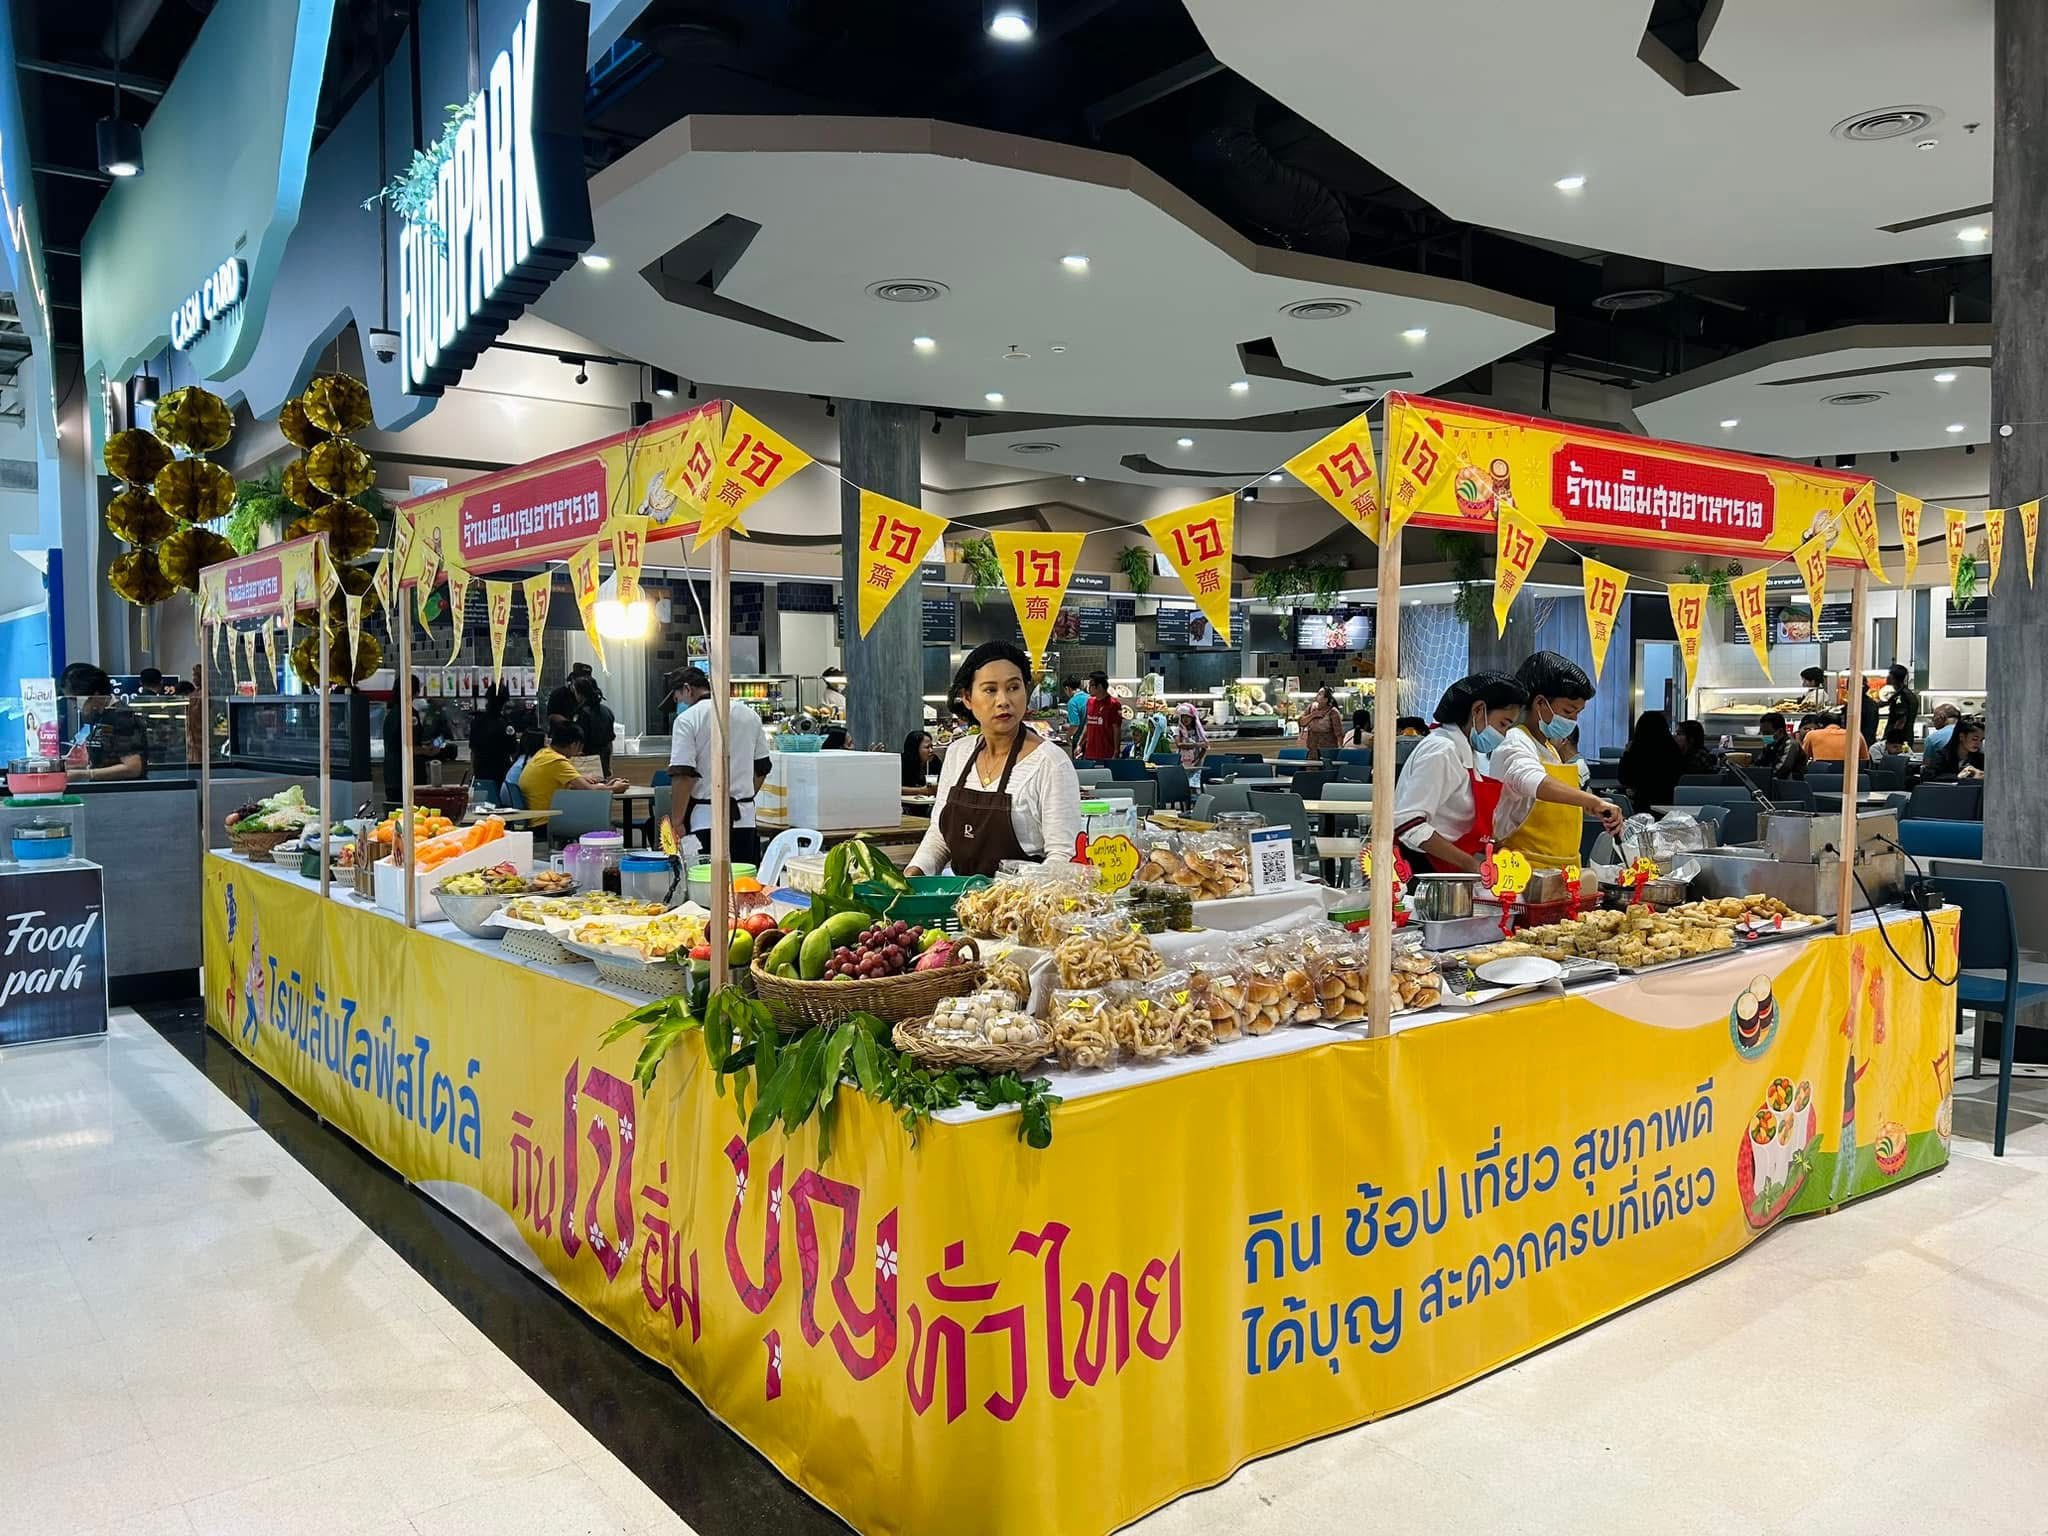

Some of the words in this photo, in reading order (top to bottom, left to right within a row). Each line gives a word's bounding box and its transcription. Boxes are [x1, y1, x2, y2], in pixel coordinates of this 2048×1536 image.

[171, 290, 201, 351] CASH
[203, 256, 240, 321] CARD
[725, 433, 783, 487] เจ
[1316, 442, 1373, 498] เจ
[1401, 431, 1439, 486] เจ
[463, 490, 600, 549] ร้านเติมบุญอาหารเจ
[1566, 459, 1764, 530] ร้านเติมสุขอาหารเจ
[617, 530, 640, 569] เจ
[869, 514, 922, 564] เจ
[1172, 518, 1225, 567] เจ
[1503, 523, 1535, 571] เจ
[1014, 550, 1061, 588] เจ
[1589, 576, 1617, 616] เจ
[1112, 872, 1127, 884] 100
[4, 911, 98, 955] Food
[0, 954, 86, 1007] park
[1244, 1209, 1321, 1284] กิน
[1345, 1166, 1447, 1257] ช้อป
[1460, 1126, 1559, 1218] เที่ยว
[1572, 1076, 1714, 1198] สุขภาพดี
[1242, 1287, 1402, 1376] ได้บุญ
[1418, 1165, 1715, 1325] สะดวกครบที่เดียว
